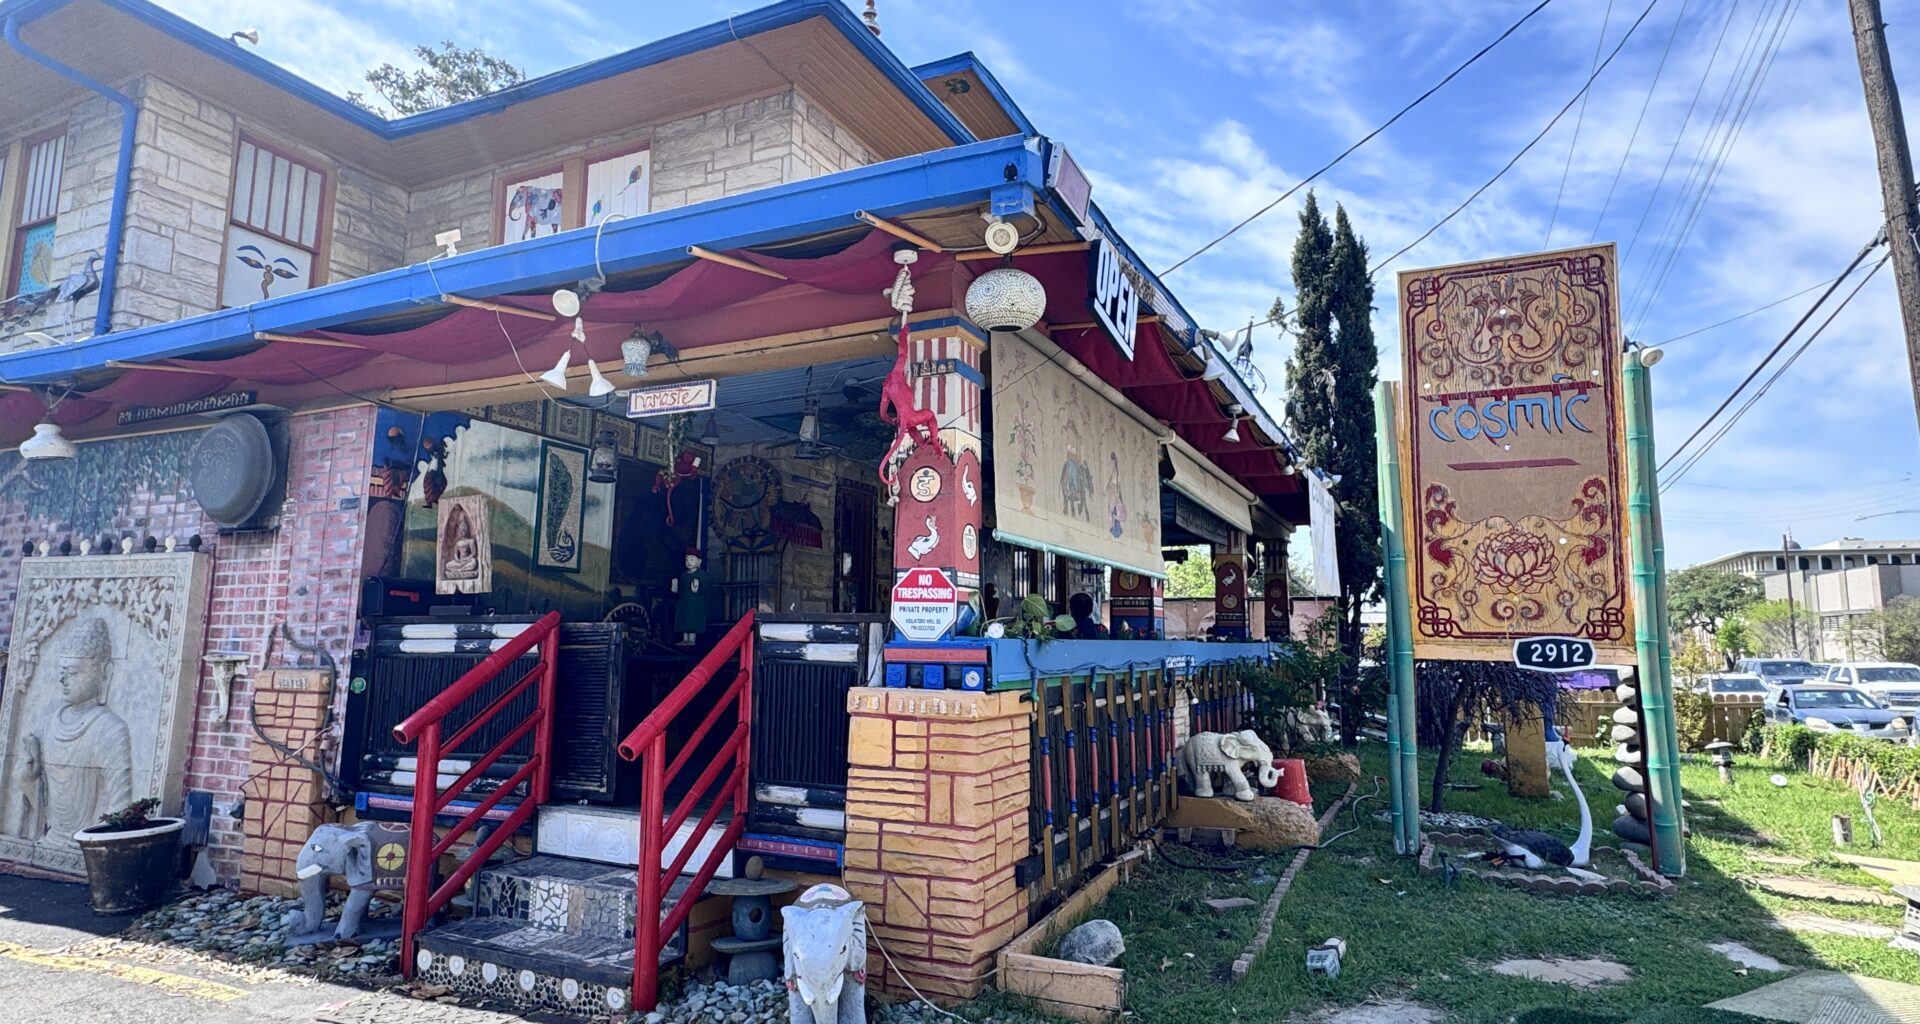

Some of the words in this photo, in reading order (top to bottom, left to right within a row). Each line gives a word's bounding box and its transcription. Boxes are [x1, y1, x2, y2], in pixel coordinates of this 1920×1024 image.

[1096, 238, 1139, 352] OPEN
[918, 574, 932, 586] NO
[897, 587, 952, 599] TRESPASSING
[1530, 643, 1585, 663] 2912
